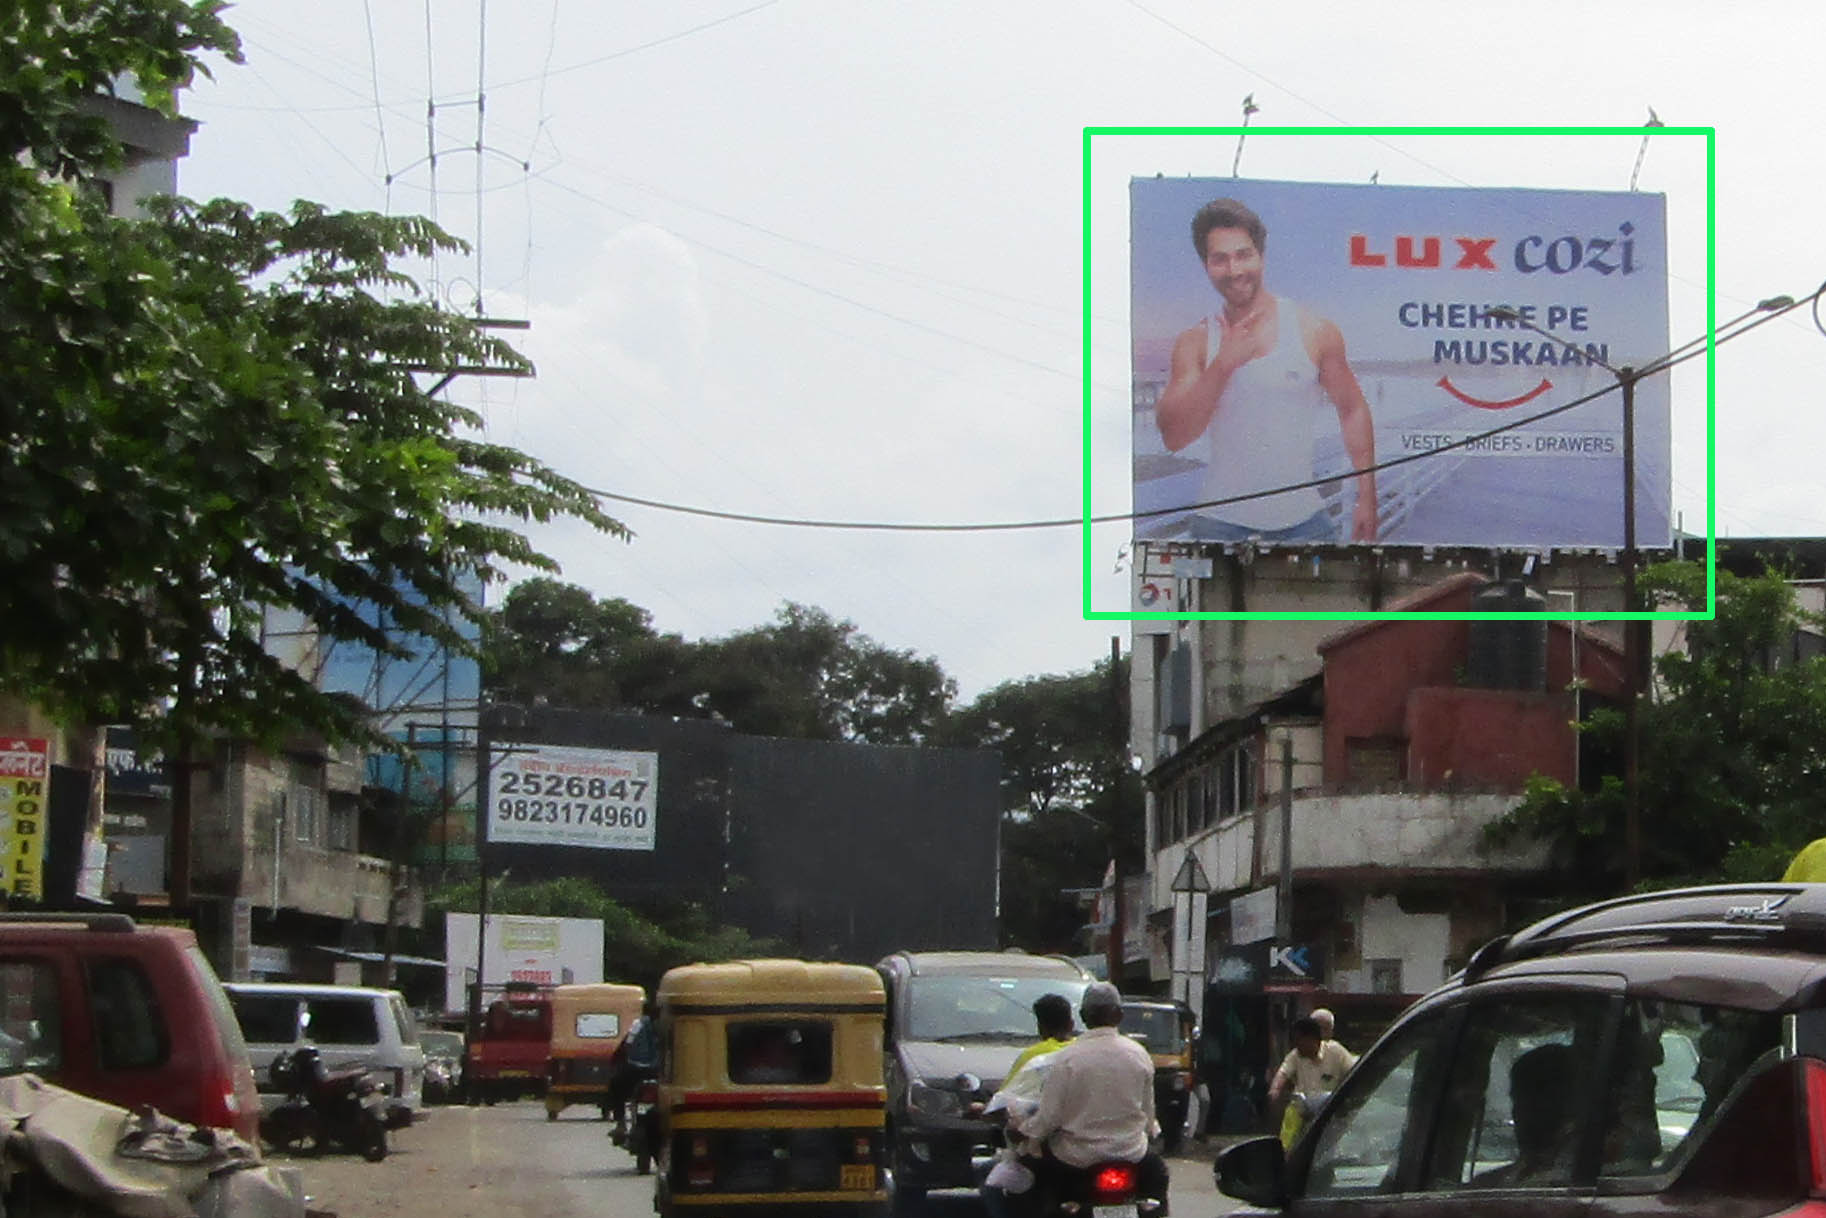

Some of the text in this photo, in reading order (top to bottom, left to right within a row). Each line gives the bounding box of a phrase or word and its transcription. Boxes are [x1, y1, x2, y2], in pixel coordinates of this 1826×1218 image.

[1350, 221, 1636, 275] LUX cozi
[1399, 302, 1589, 331] CHEHRE PE
[1433, 340, 1609, 367] MUSKAAN
[1402, 435, 1615, 453] VESTS BRIEFS DRAWERS
[499, 772, 649, 802] 2526847
[498, 799, 647, 829] 9823174960
